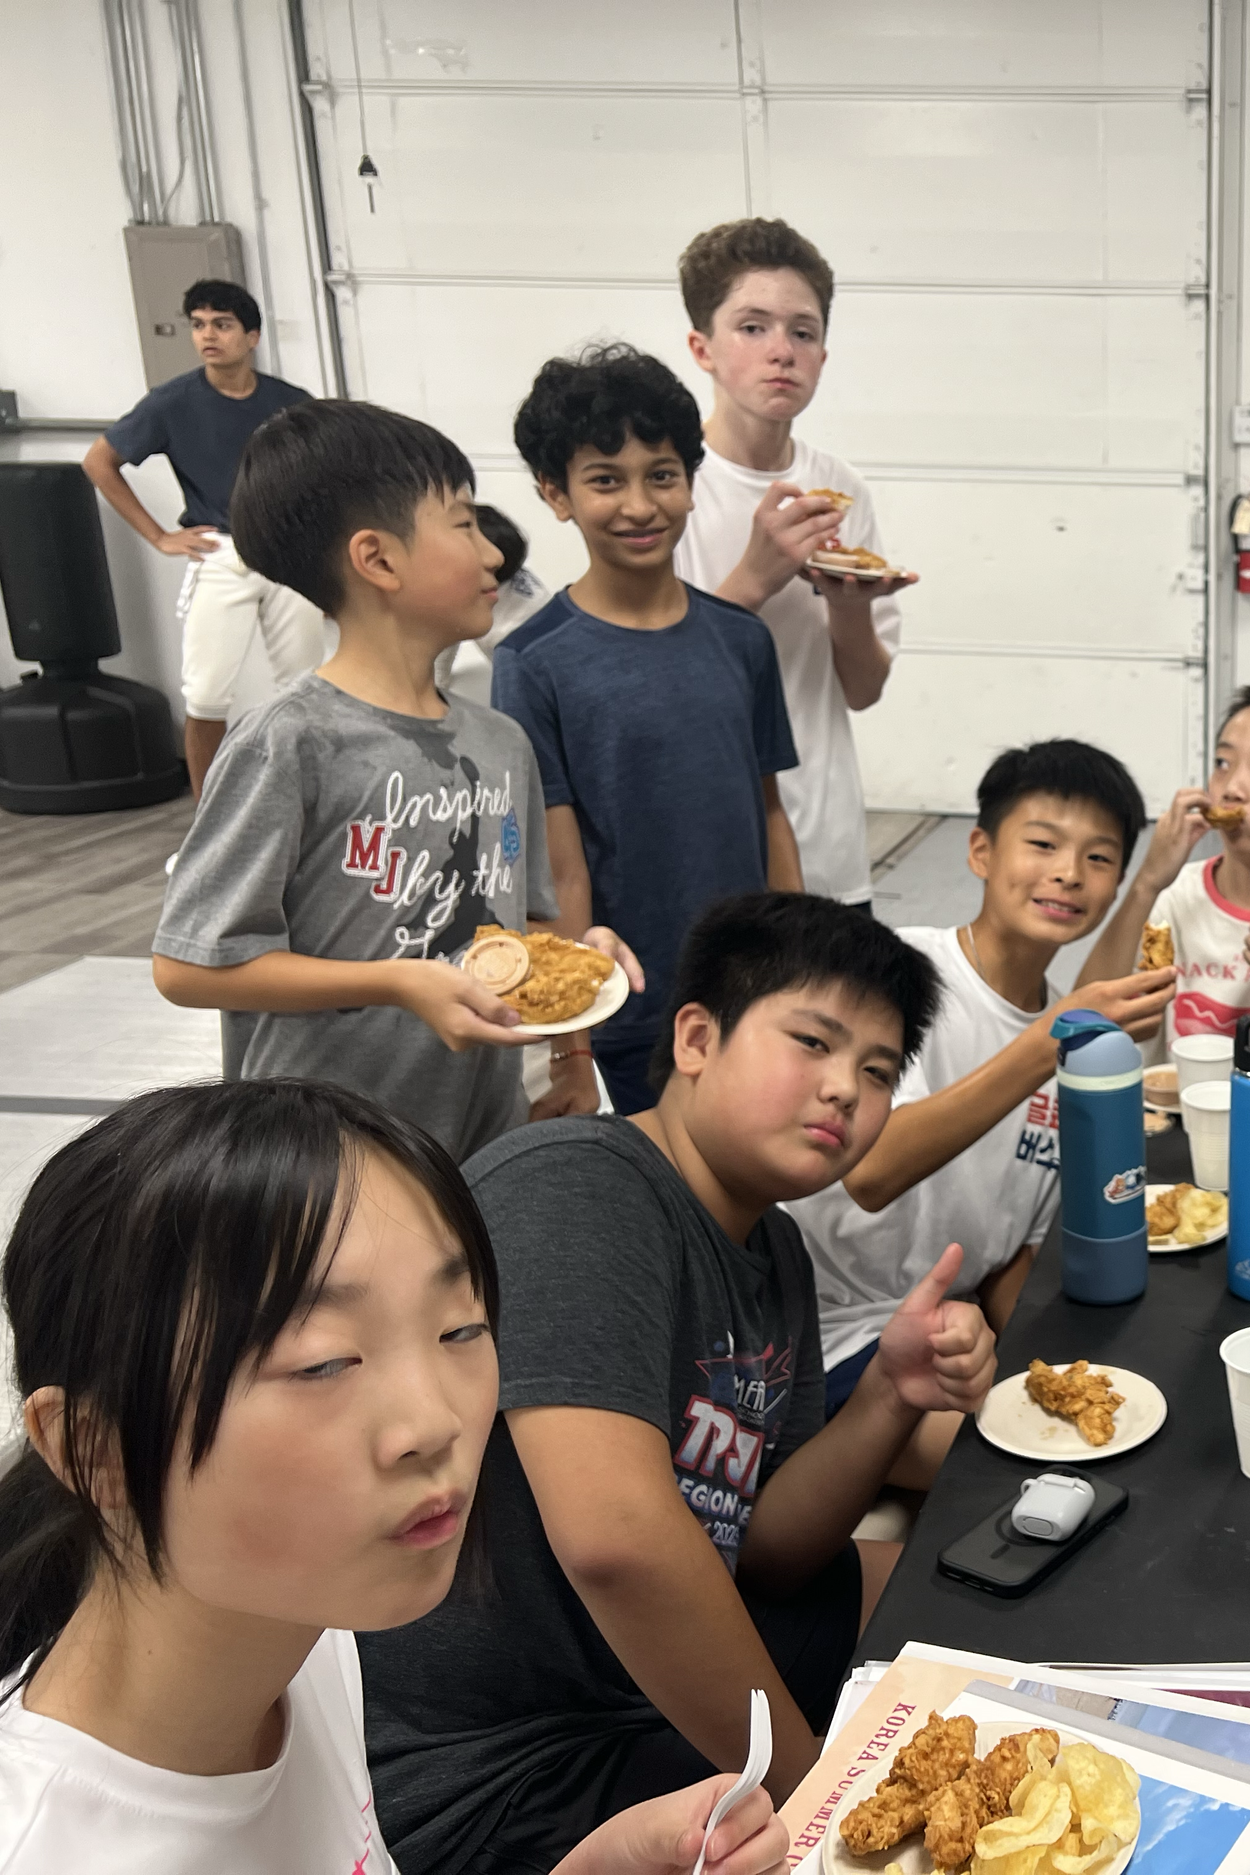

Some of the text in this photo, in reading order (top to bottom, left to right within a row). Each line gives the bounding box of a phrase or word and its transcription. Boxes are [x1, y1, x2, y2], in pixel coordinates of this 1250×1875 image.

[367, 770, 512, 844] Inspired
[342, 821, 406, 902] MJ
[394, 841, 513, 928] by the
[1176, 961, 1237, 980] NACK
[675, 1474, 739, 1517] EGION
[794, 1702, 917, 1848] KOREA SUMMER
